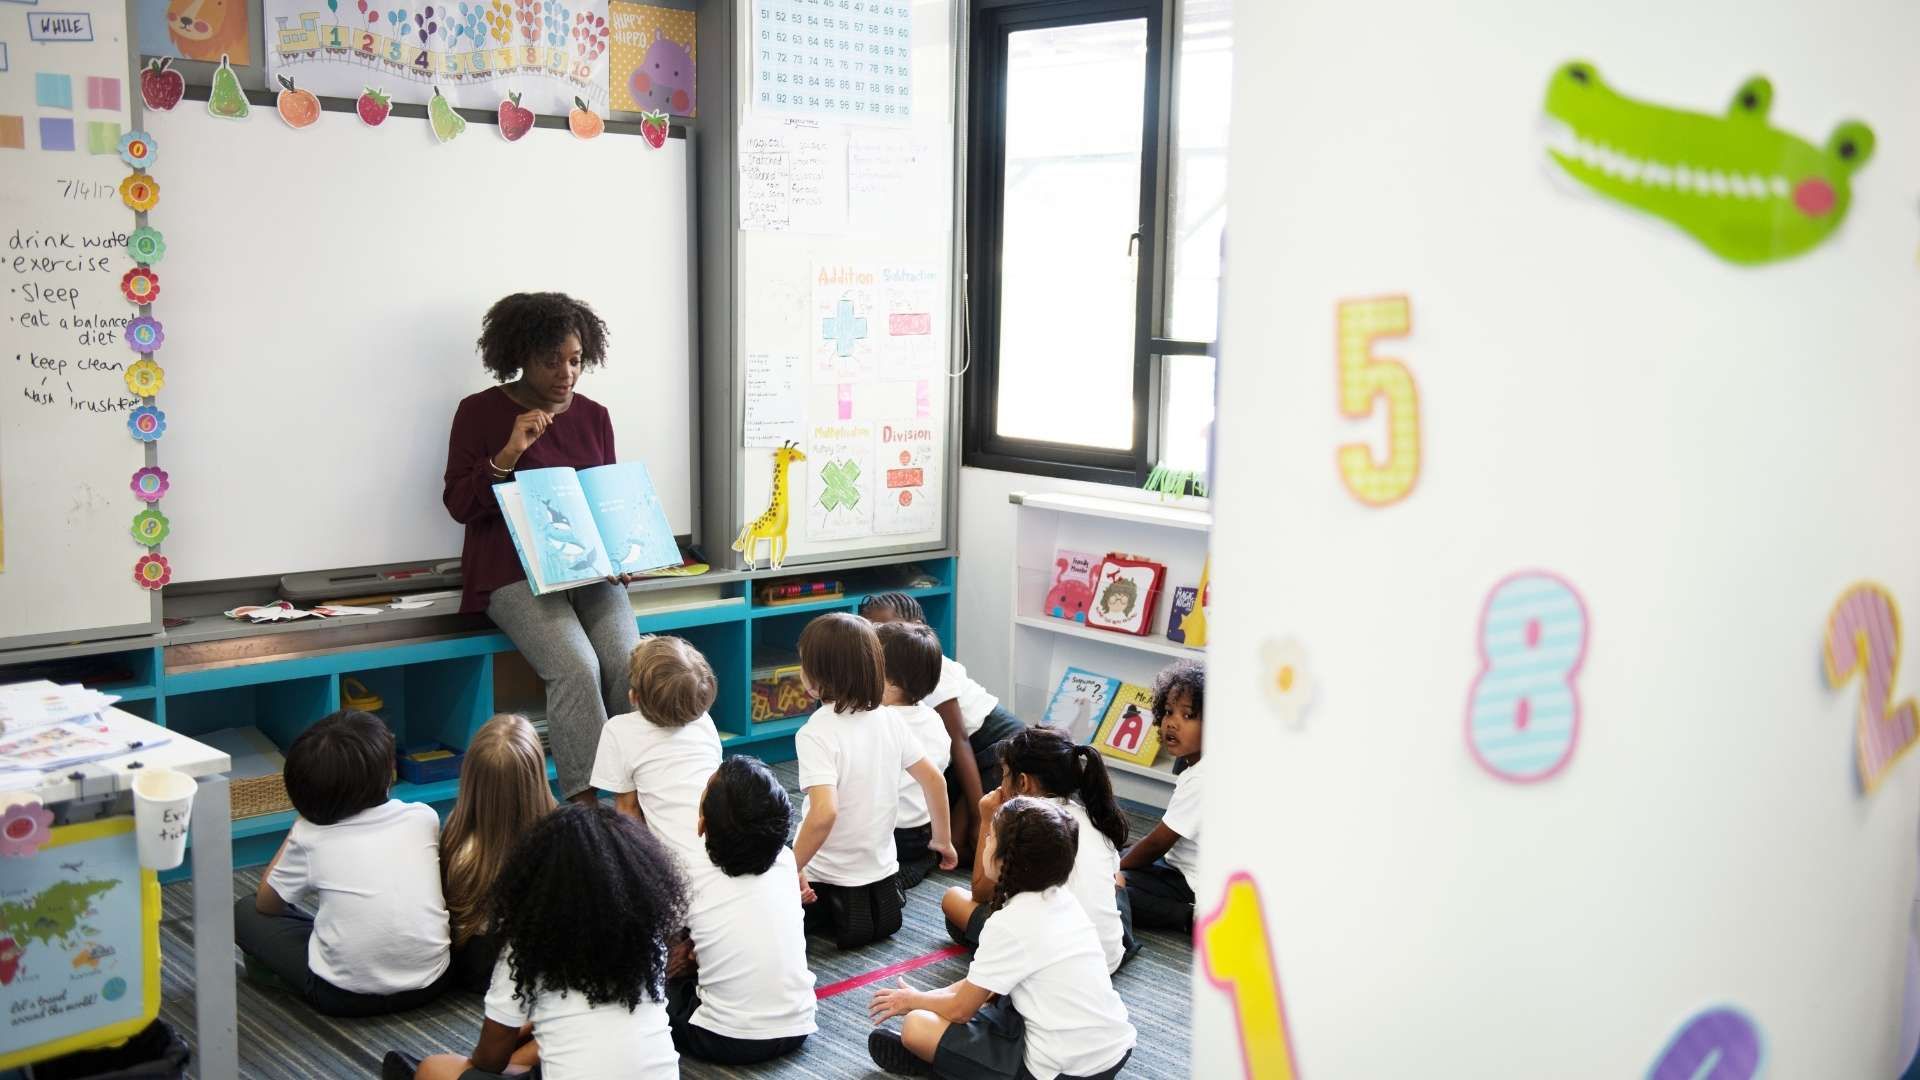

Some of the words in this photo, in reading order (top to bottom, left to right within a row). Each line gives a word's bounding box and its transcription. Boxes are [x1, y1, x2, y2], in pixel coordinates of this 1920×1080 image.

[854, 2, 864, 12] 47
[41, 17, 84, 35] WHILE
[761, 9, 770, 19] 51
[776, 11, 786, 22] 52
[808, 16, 818, 26] 54
[824, 18, 834, 28] 55
[854, 22, 864, 32] 57
[868, 24, 879, 34] 58
[884, 26, 894, 36] 59
[898, 28, 908, 38] 60
[331, 27, 342, 48] 1
[362, 34, 374, 54] 2
[390, 42, 401, 60] 3
[415, 51, 429, 69] 4
[526, 47, 536, 64] 8
[572, 62, 591, 78] 10
[762, 30, 770, 40] 61
[776, 32, 787, 42] 62
[792, 34, 802, 44] 63
[808, 36, 818, 46] 64
[824, 38, 834, 48] 65
[854, 42, 864, 52] 67
[898, 48, 908, 58] 70
[762, 50, 770, 60] 71
[776, 52, 788, 62] 72
[793, 54, 802, 64] 73
[808, 56, 818, 66] 74
[824, 58, 834, 68] 75
[840, 60, 849, 70] 76
[854, 62, 864, 72] 77
[869, 64, 879, 74] 78
[884, 65, 894, 75] 79
[762, 71, 771, 81] 81
[776, 72, 788, 83] 82
[793, 74, 803, 85] 83
[808, 76, 820, 86] 84
[855, 82, 864, 92] 87
[869, 83, 880, 93] 88
[898, 86, 908, 96] 90
[762, 92, 770, 102] 91
[776, 94, 787, 104] 92
[808, 97, 820, 107] 94
[824, 98, 834, 108] 95
[840, 100, 850, 110] 96
[855, 102, 864, 112] 97
[133, 143, 143, 156] 0
[9, 229, 75, 250] drink
[13, 255, 111, 273] exercise
[818, 266, 874, 286] Addition
[20, 310, 50, 328] eat
[59, 318, 69, 330] a
[78, 331, 117, 346] diet
[77, 357, 124, 371] clean
[140, 372, 150, 385] 5
[1332, 291, 1424, 509] 5
[882, 425, 931, 443] Division
[145, 520, 157, 534] 8
[1465, 567, 1590, 786] 8
[1825, 580, 1920, 794] 2
[1194, 870, 1303, 1080] 1
